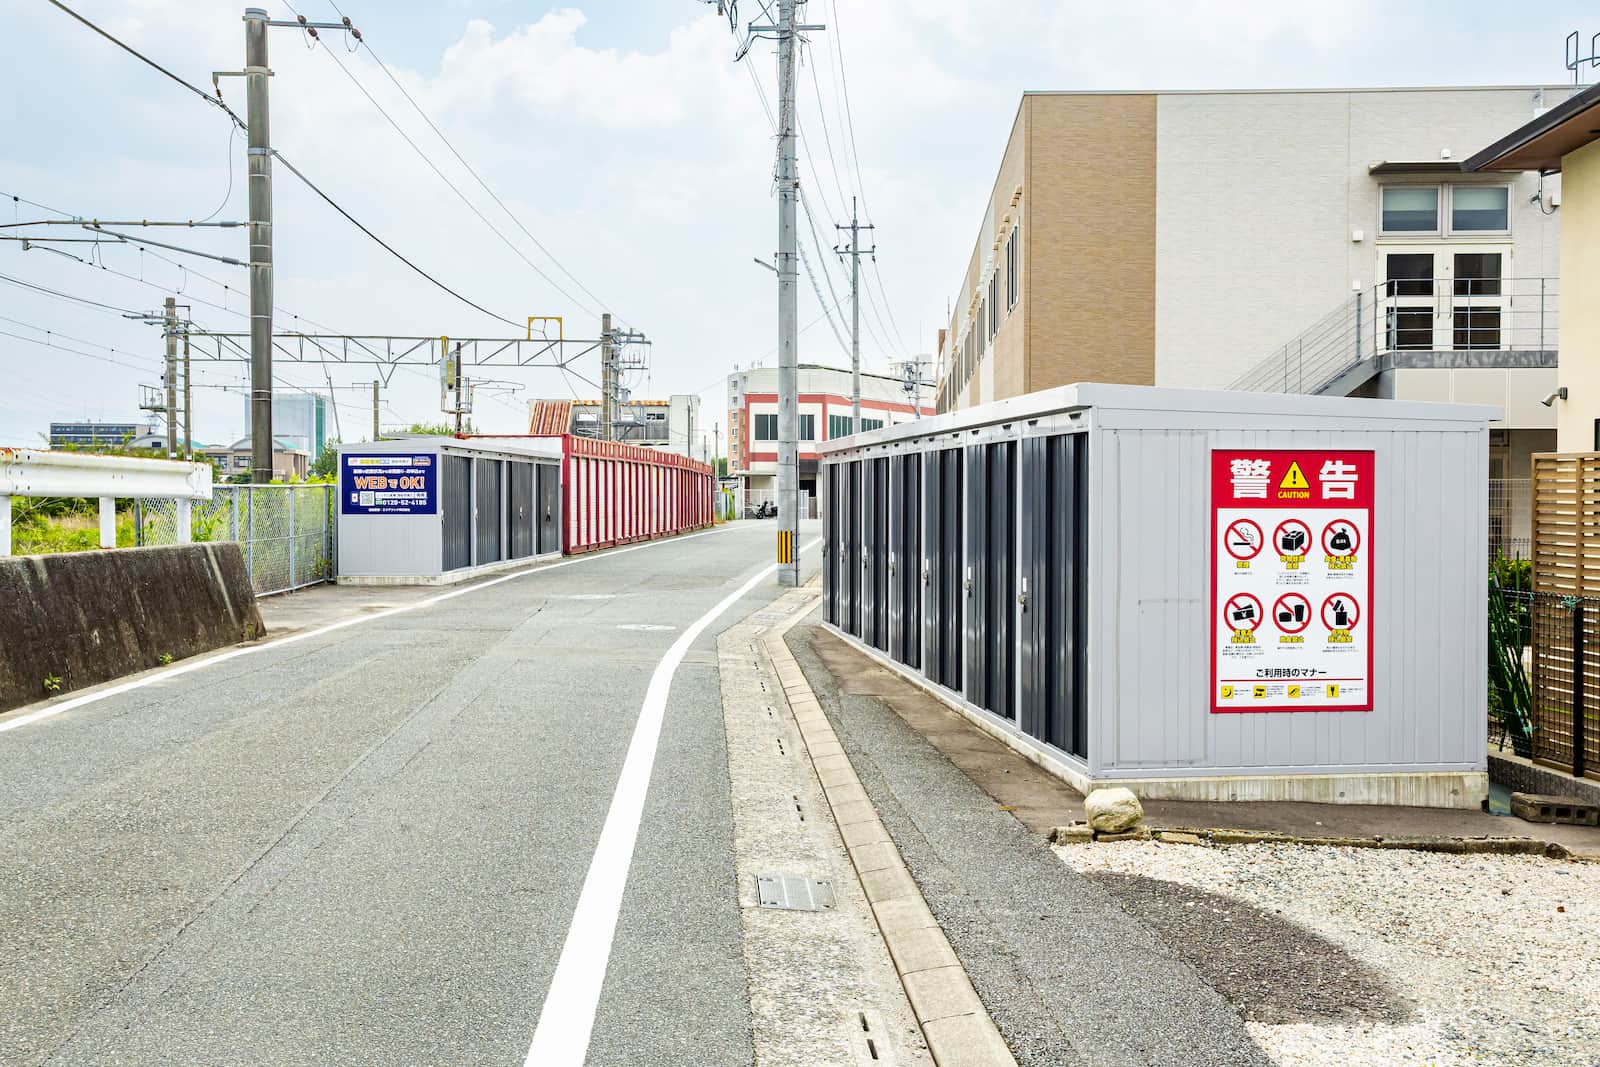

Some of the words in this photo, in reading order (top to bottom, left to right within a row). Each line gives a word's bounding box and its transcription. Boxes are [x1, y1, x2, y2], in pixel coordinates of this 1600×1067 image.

[1230, 459, 1271, 498] 警
[1319, 460, 1358, 500] 告
[1278, 491, 1310, 499] CAUTION
[1256, 668, 1327, 678] ご利用時のマナー
